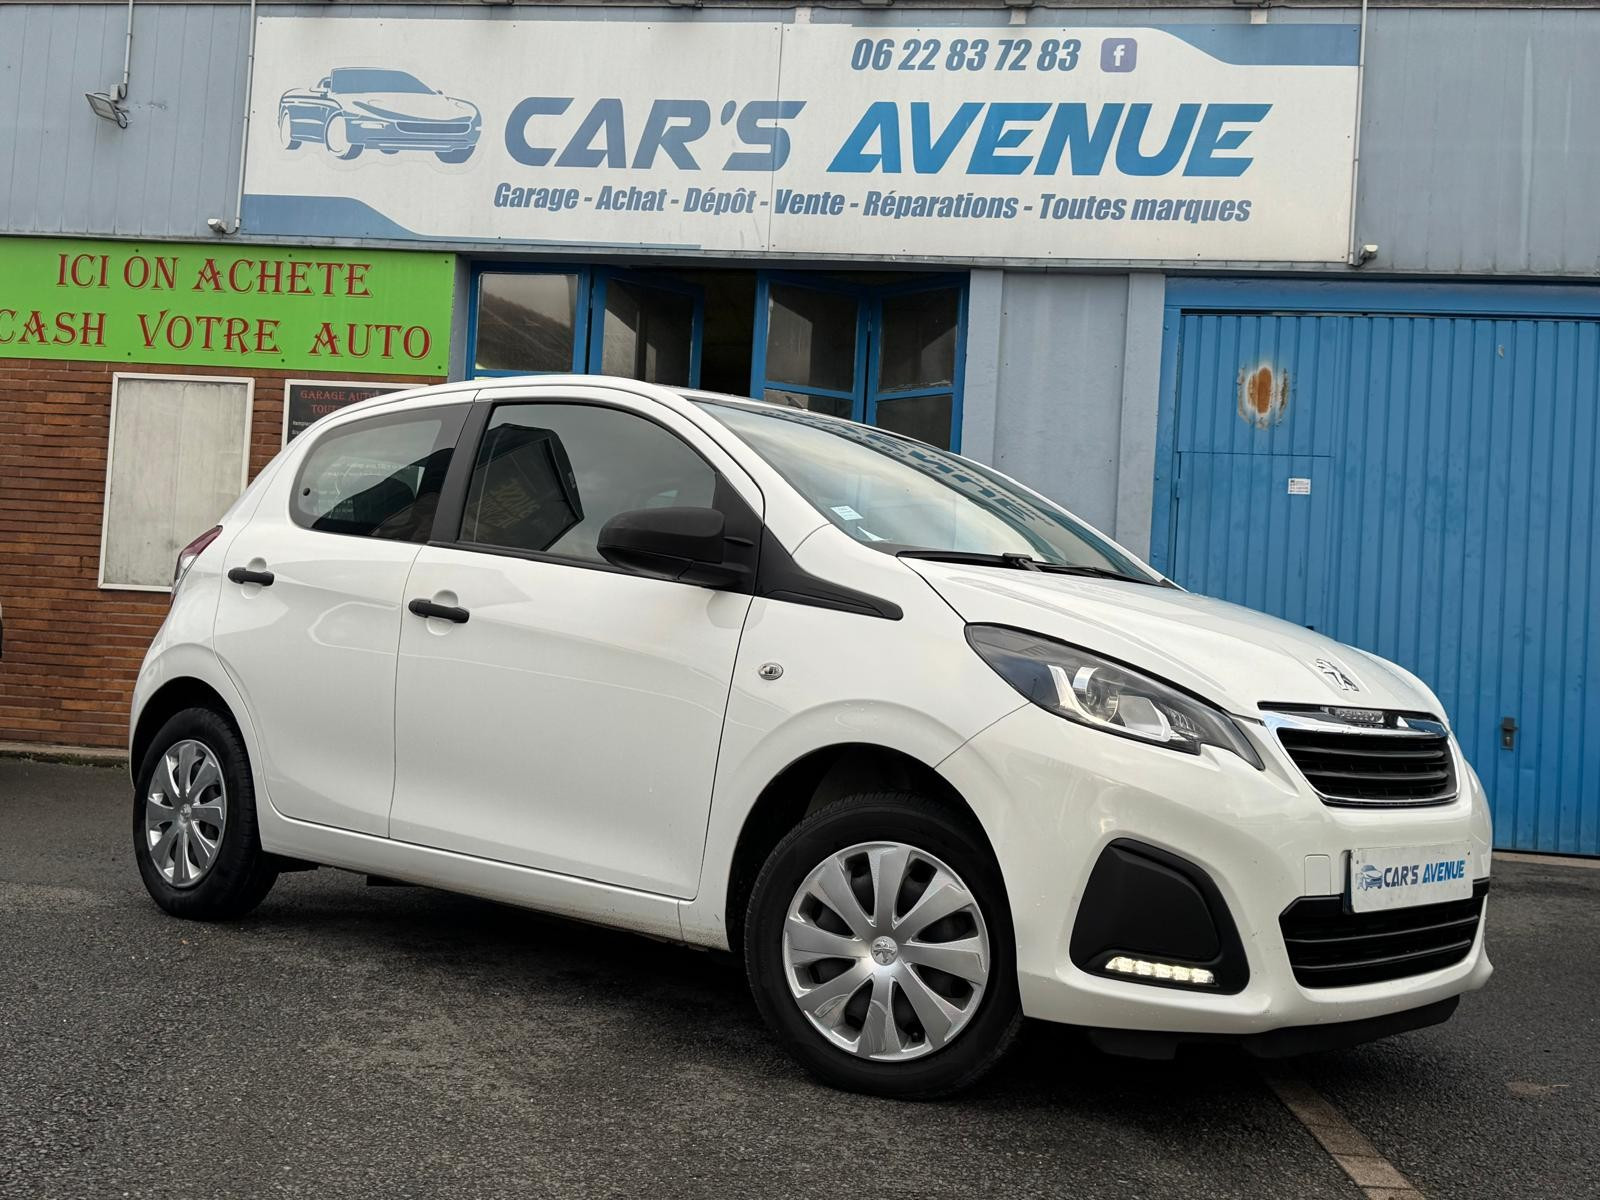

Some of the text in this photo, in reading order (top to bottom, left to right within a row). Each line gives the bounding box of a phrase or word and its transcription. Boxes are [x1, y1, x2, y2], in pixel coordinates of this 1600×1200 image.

[851, 38, 1082, 71] 06 22 83 72 83
[504, 96, 1273, 177] CAR'S AVENUE
[493, 182, 580, 212] Garage
[595, 186, 667, 212] Achat
[683, 187, 756, 216] Dépôt
[774, 189, 845, 216] Vente
[863, 190, 1018, 219] Réparations
[1039, 193, 1126, 221] Toutes
[1130, 198, 1252, 224] marques
[56, 253, 374, 298] ICI ON ACHETE
[0, 309, 433, 360] CASH VOTRE AUTO
[300, 390, 346, 401] GARAGE
[1383, 860, 1466, 888] CAR'S AVENUE
